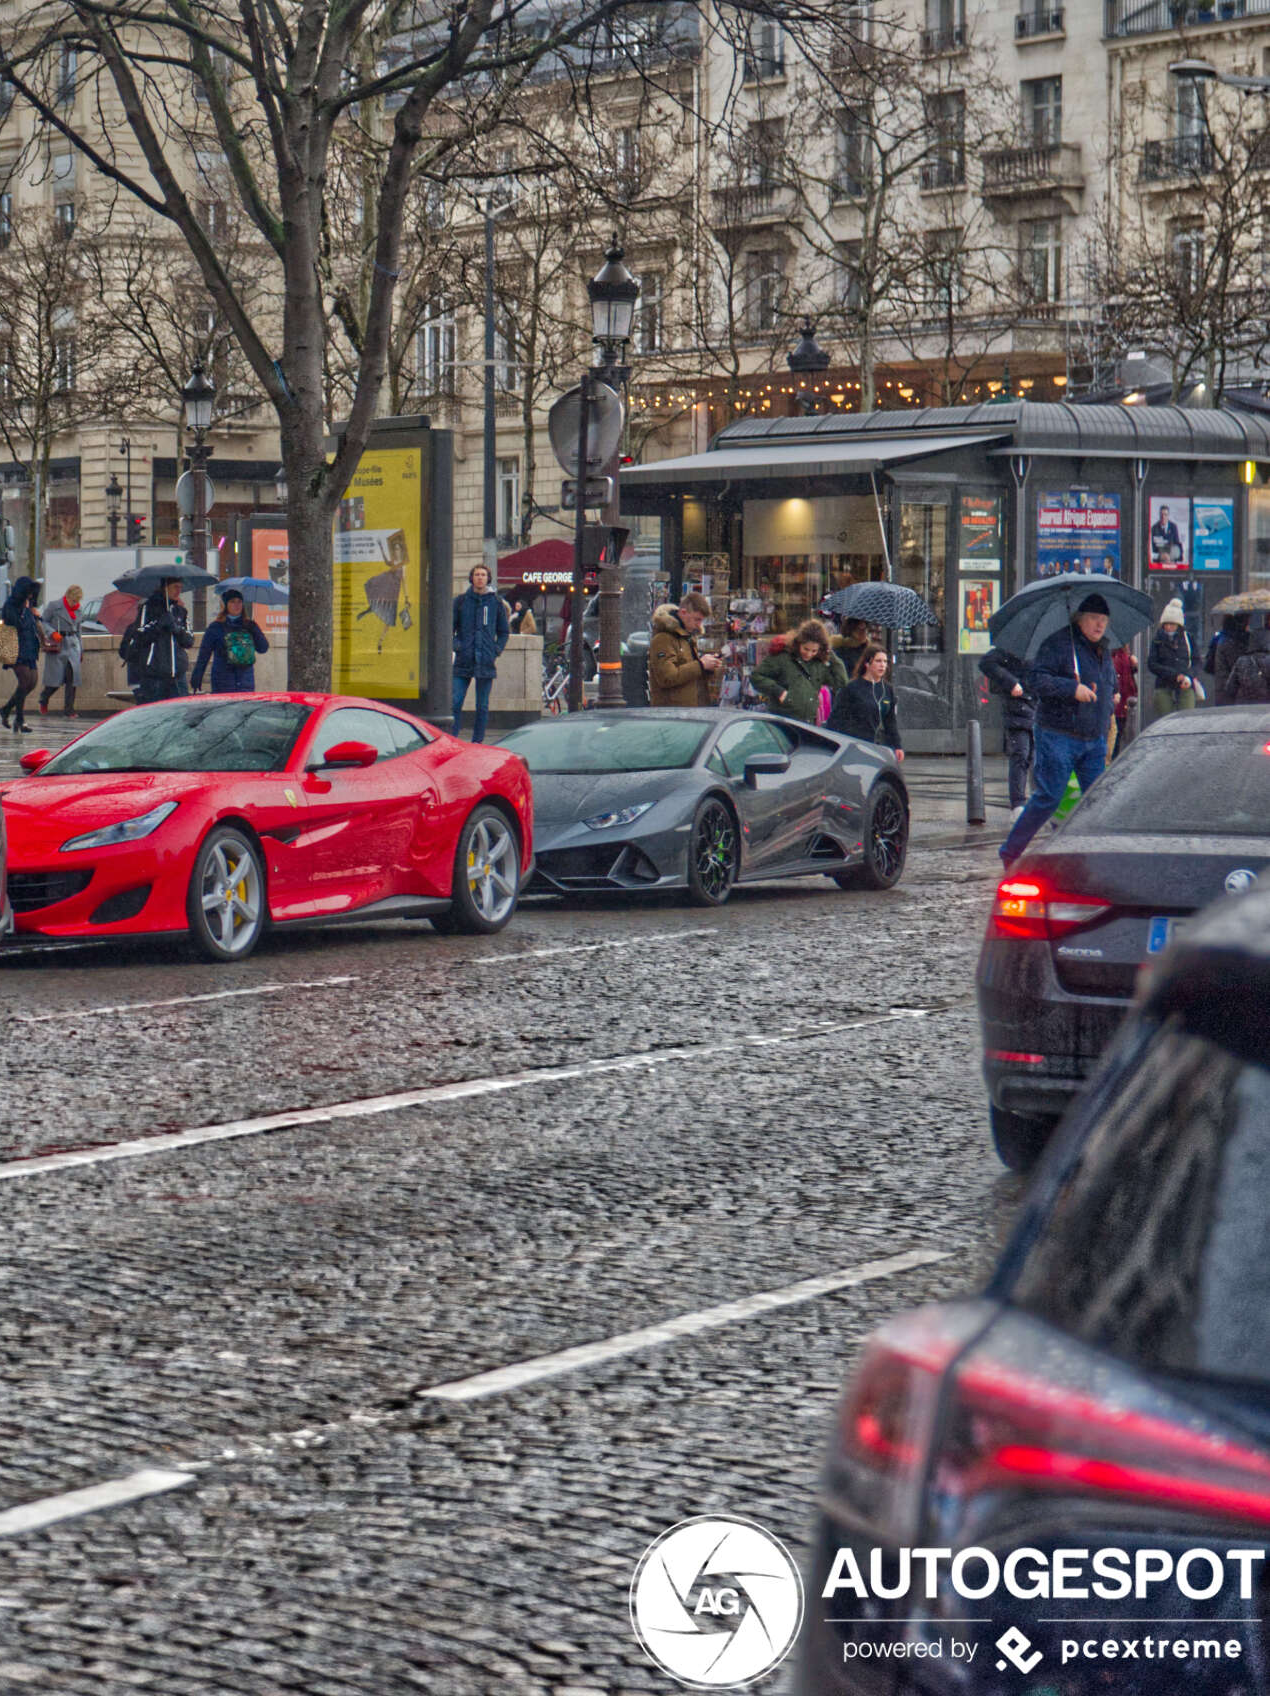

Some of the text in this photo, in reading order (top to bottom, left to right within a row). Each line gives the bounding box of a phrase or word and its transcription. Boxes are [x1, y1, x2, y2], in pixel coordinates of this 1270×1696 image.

[1064, 508, 1086, 528] Afrique
[1087, 509, 1118, 528] Expansion
[543, 571, 574, 583] GEORGE
